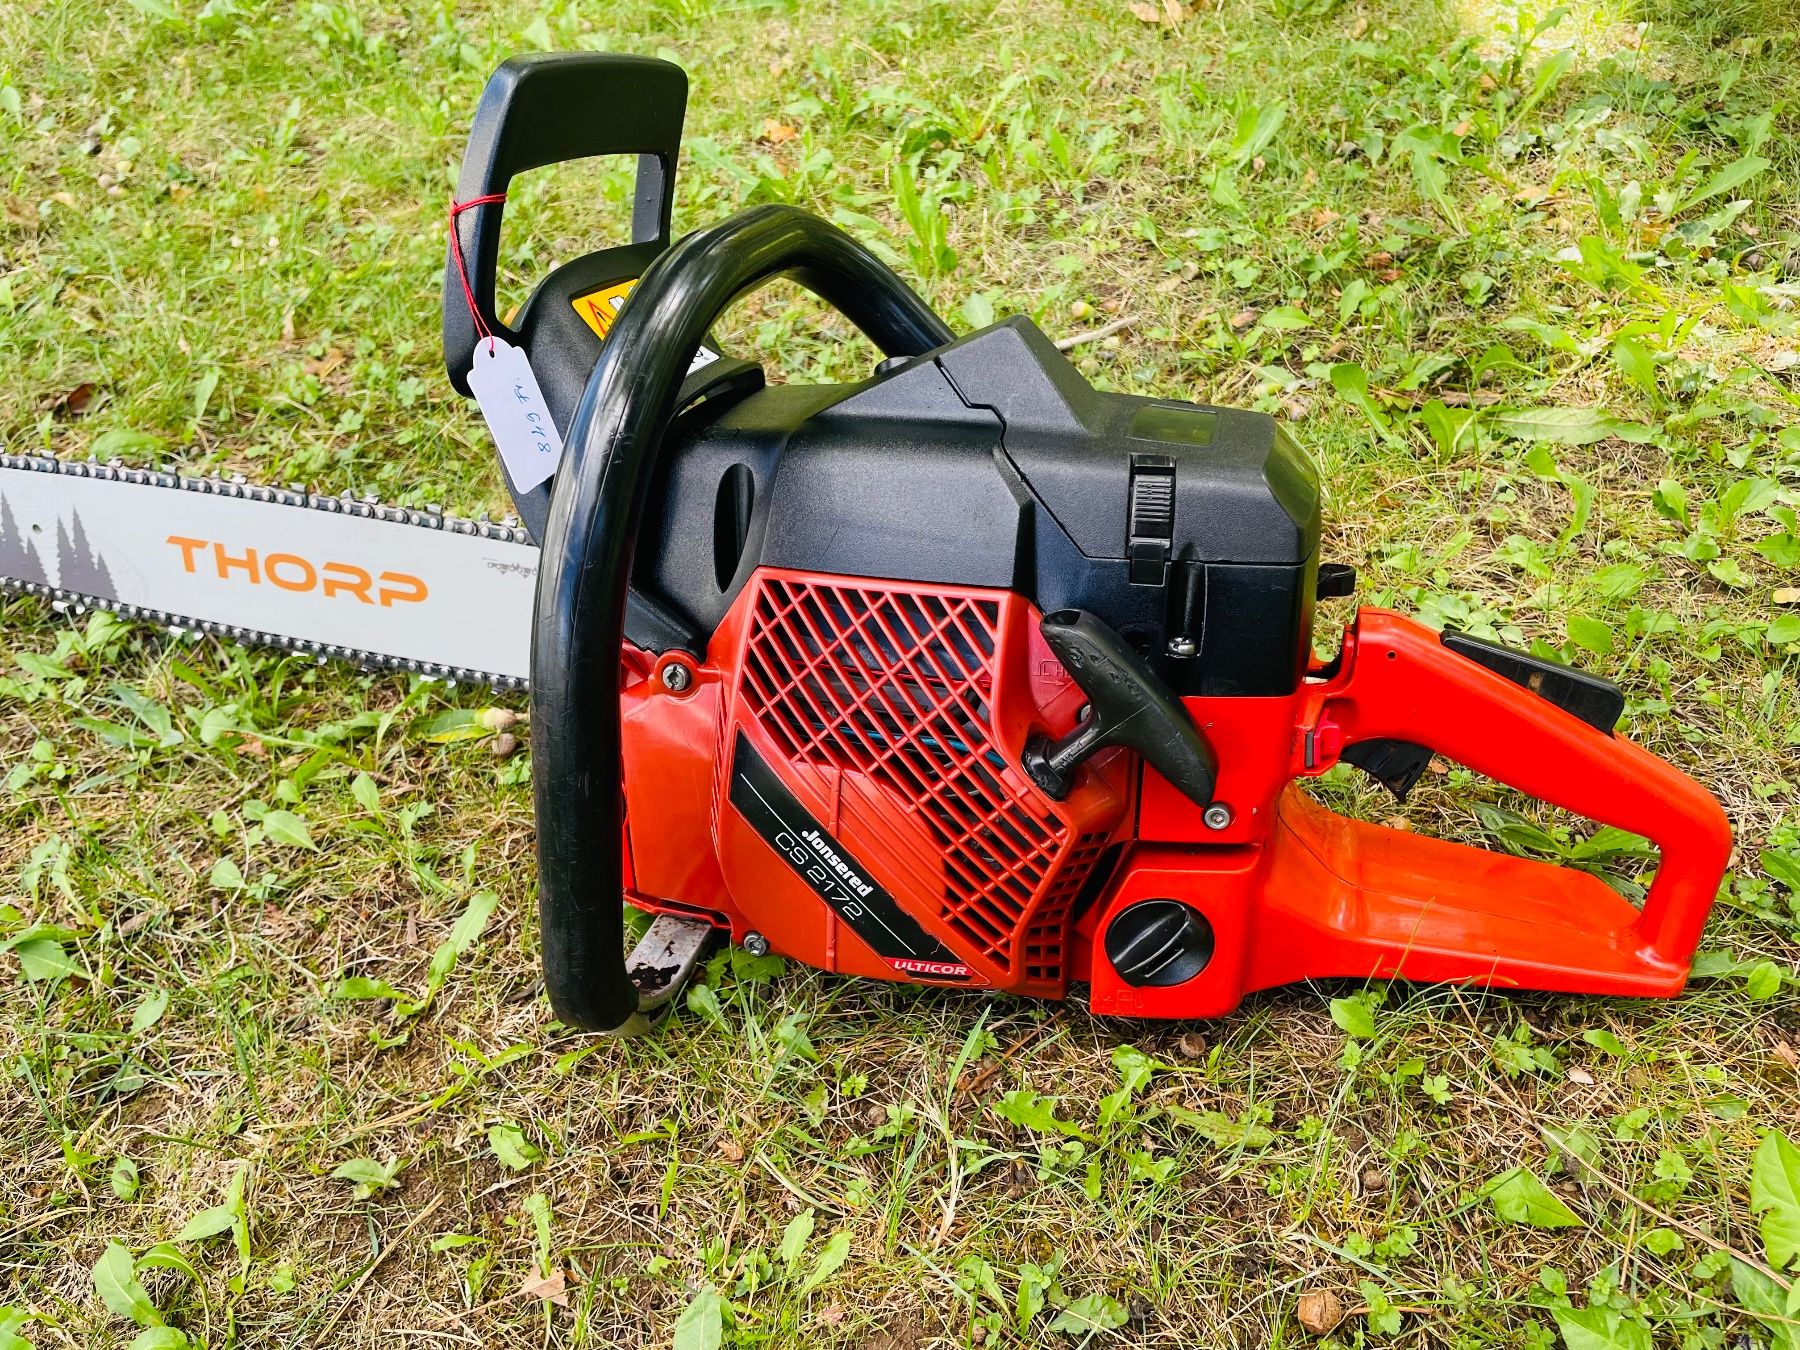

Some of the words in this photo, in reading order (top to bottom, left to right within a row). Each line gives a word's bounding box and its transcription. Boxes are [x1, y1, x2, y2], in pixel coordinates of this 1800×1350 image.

[166, 535, 429, 607] THORP
[775, 831, 809, 866] CS
[806, 865, 863, 921] 2172
[801, 830, 874, 898] Jonsered
[894, 960, 967, 975] ULTICOR
